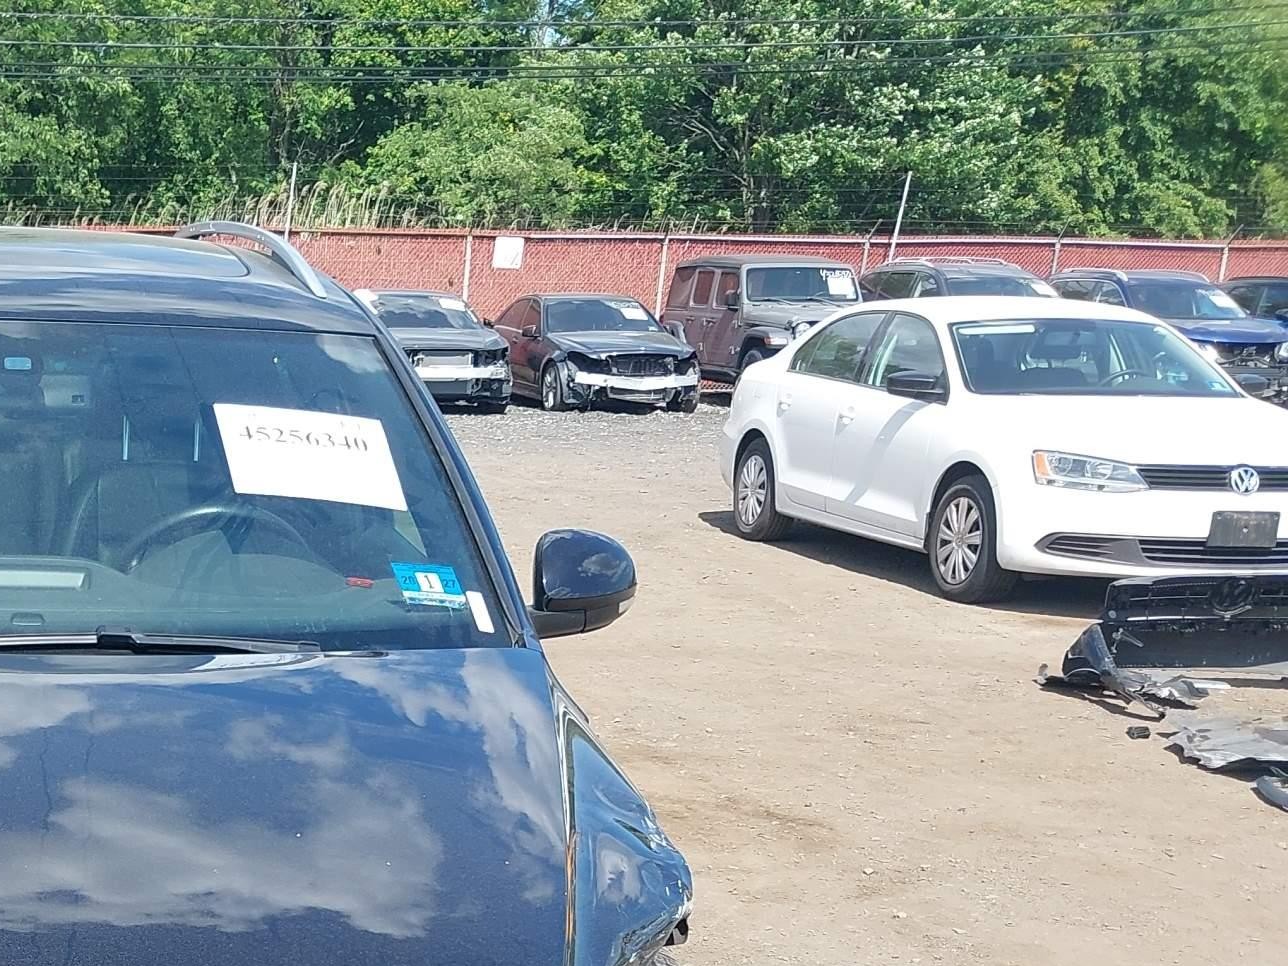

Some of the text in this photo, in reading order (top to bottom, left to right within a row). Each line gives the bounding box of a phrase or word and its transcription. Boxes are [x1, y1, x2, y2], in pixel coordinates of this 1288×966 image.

[239, 425, 368, 451] 45256340
[401, 574, 457, 589] 20 1 27
